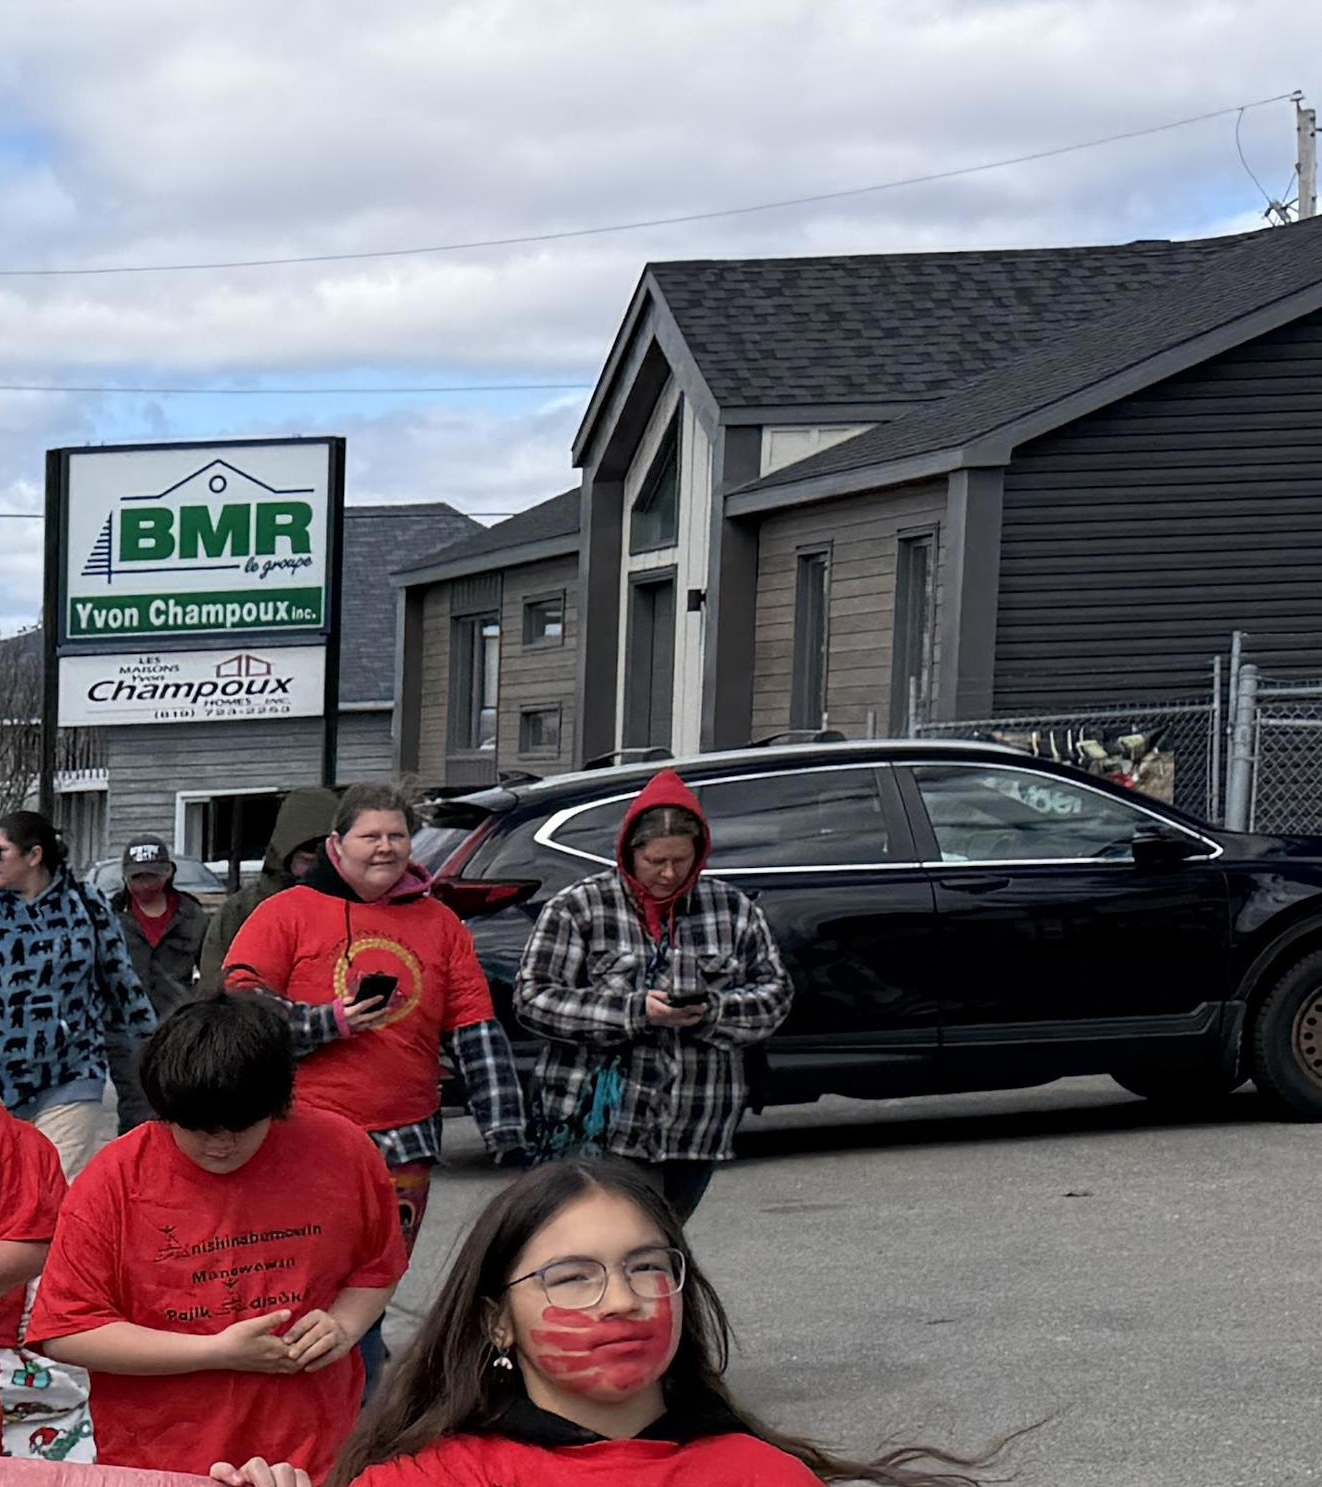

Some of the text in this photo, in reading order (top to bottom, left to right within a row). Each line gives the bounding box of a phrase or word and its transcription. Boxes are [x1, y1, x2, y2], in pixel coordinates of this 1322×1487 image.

[119, 501, 313, 562] BMR
[245, 555, 312, 580] le groupe
[76, 599, 316, 630] Yvon Champoux inc.
[119, 664, 180, 675] MAISONS
[139, 656, 161, 665] LES
[88, 677, 294, 704] Champoux
